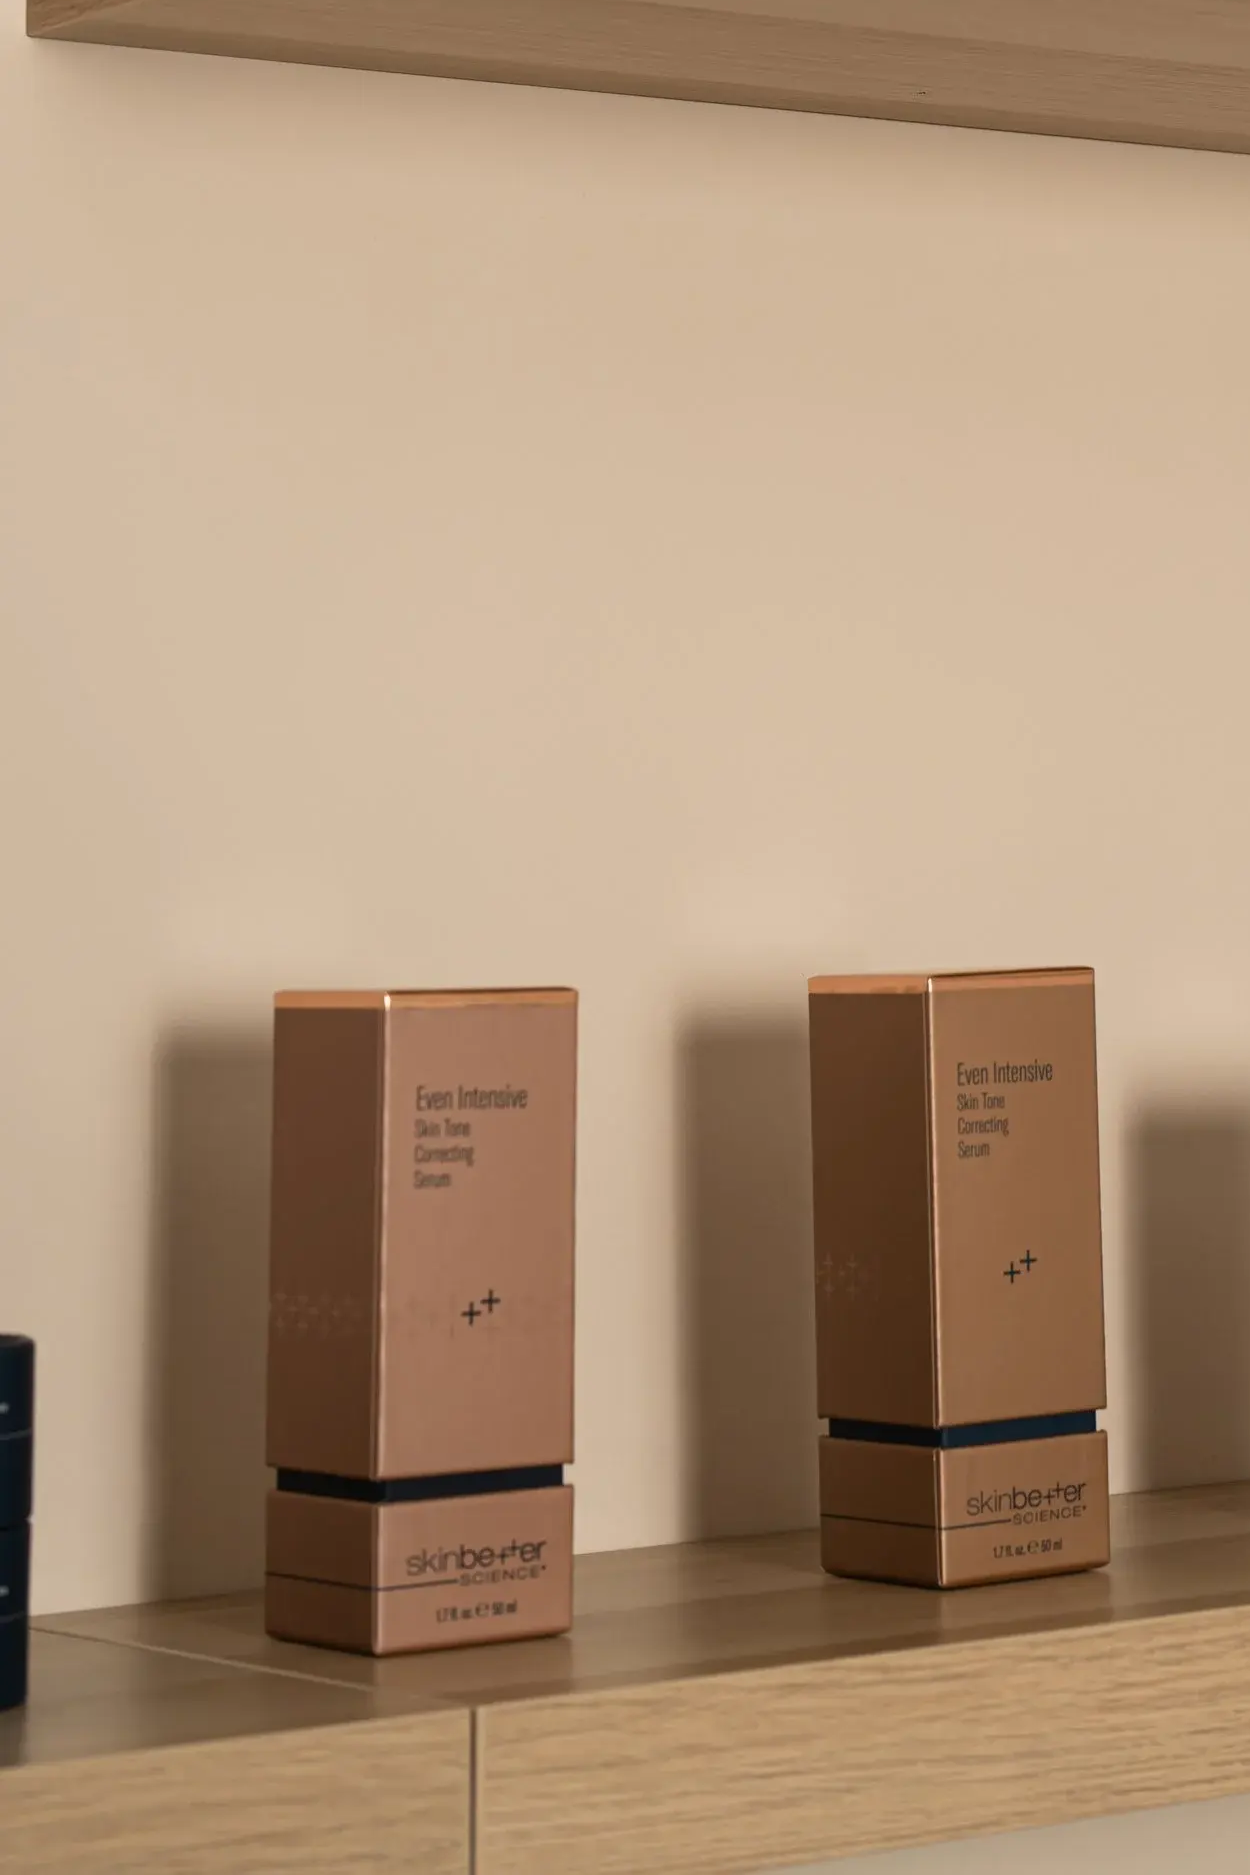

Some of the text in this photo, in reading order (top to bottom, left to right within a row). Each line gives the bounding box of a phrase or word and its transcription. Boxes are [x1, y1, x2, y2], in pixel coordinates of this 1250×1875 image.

[957, 1059, 1053, 1086] Even Intensive
[416, 1084, 528, 1111] Even Intensive
[957, 1092, 1005, 1111] Skin Tone
[957, 1116, 1010, 1138] Correcting
[957, 1141, 990, 1159] Serum
